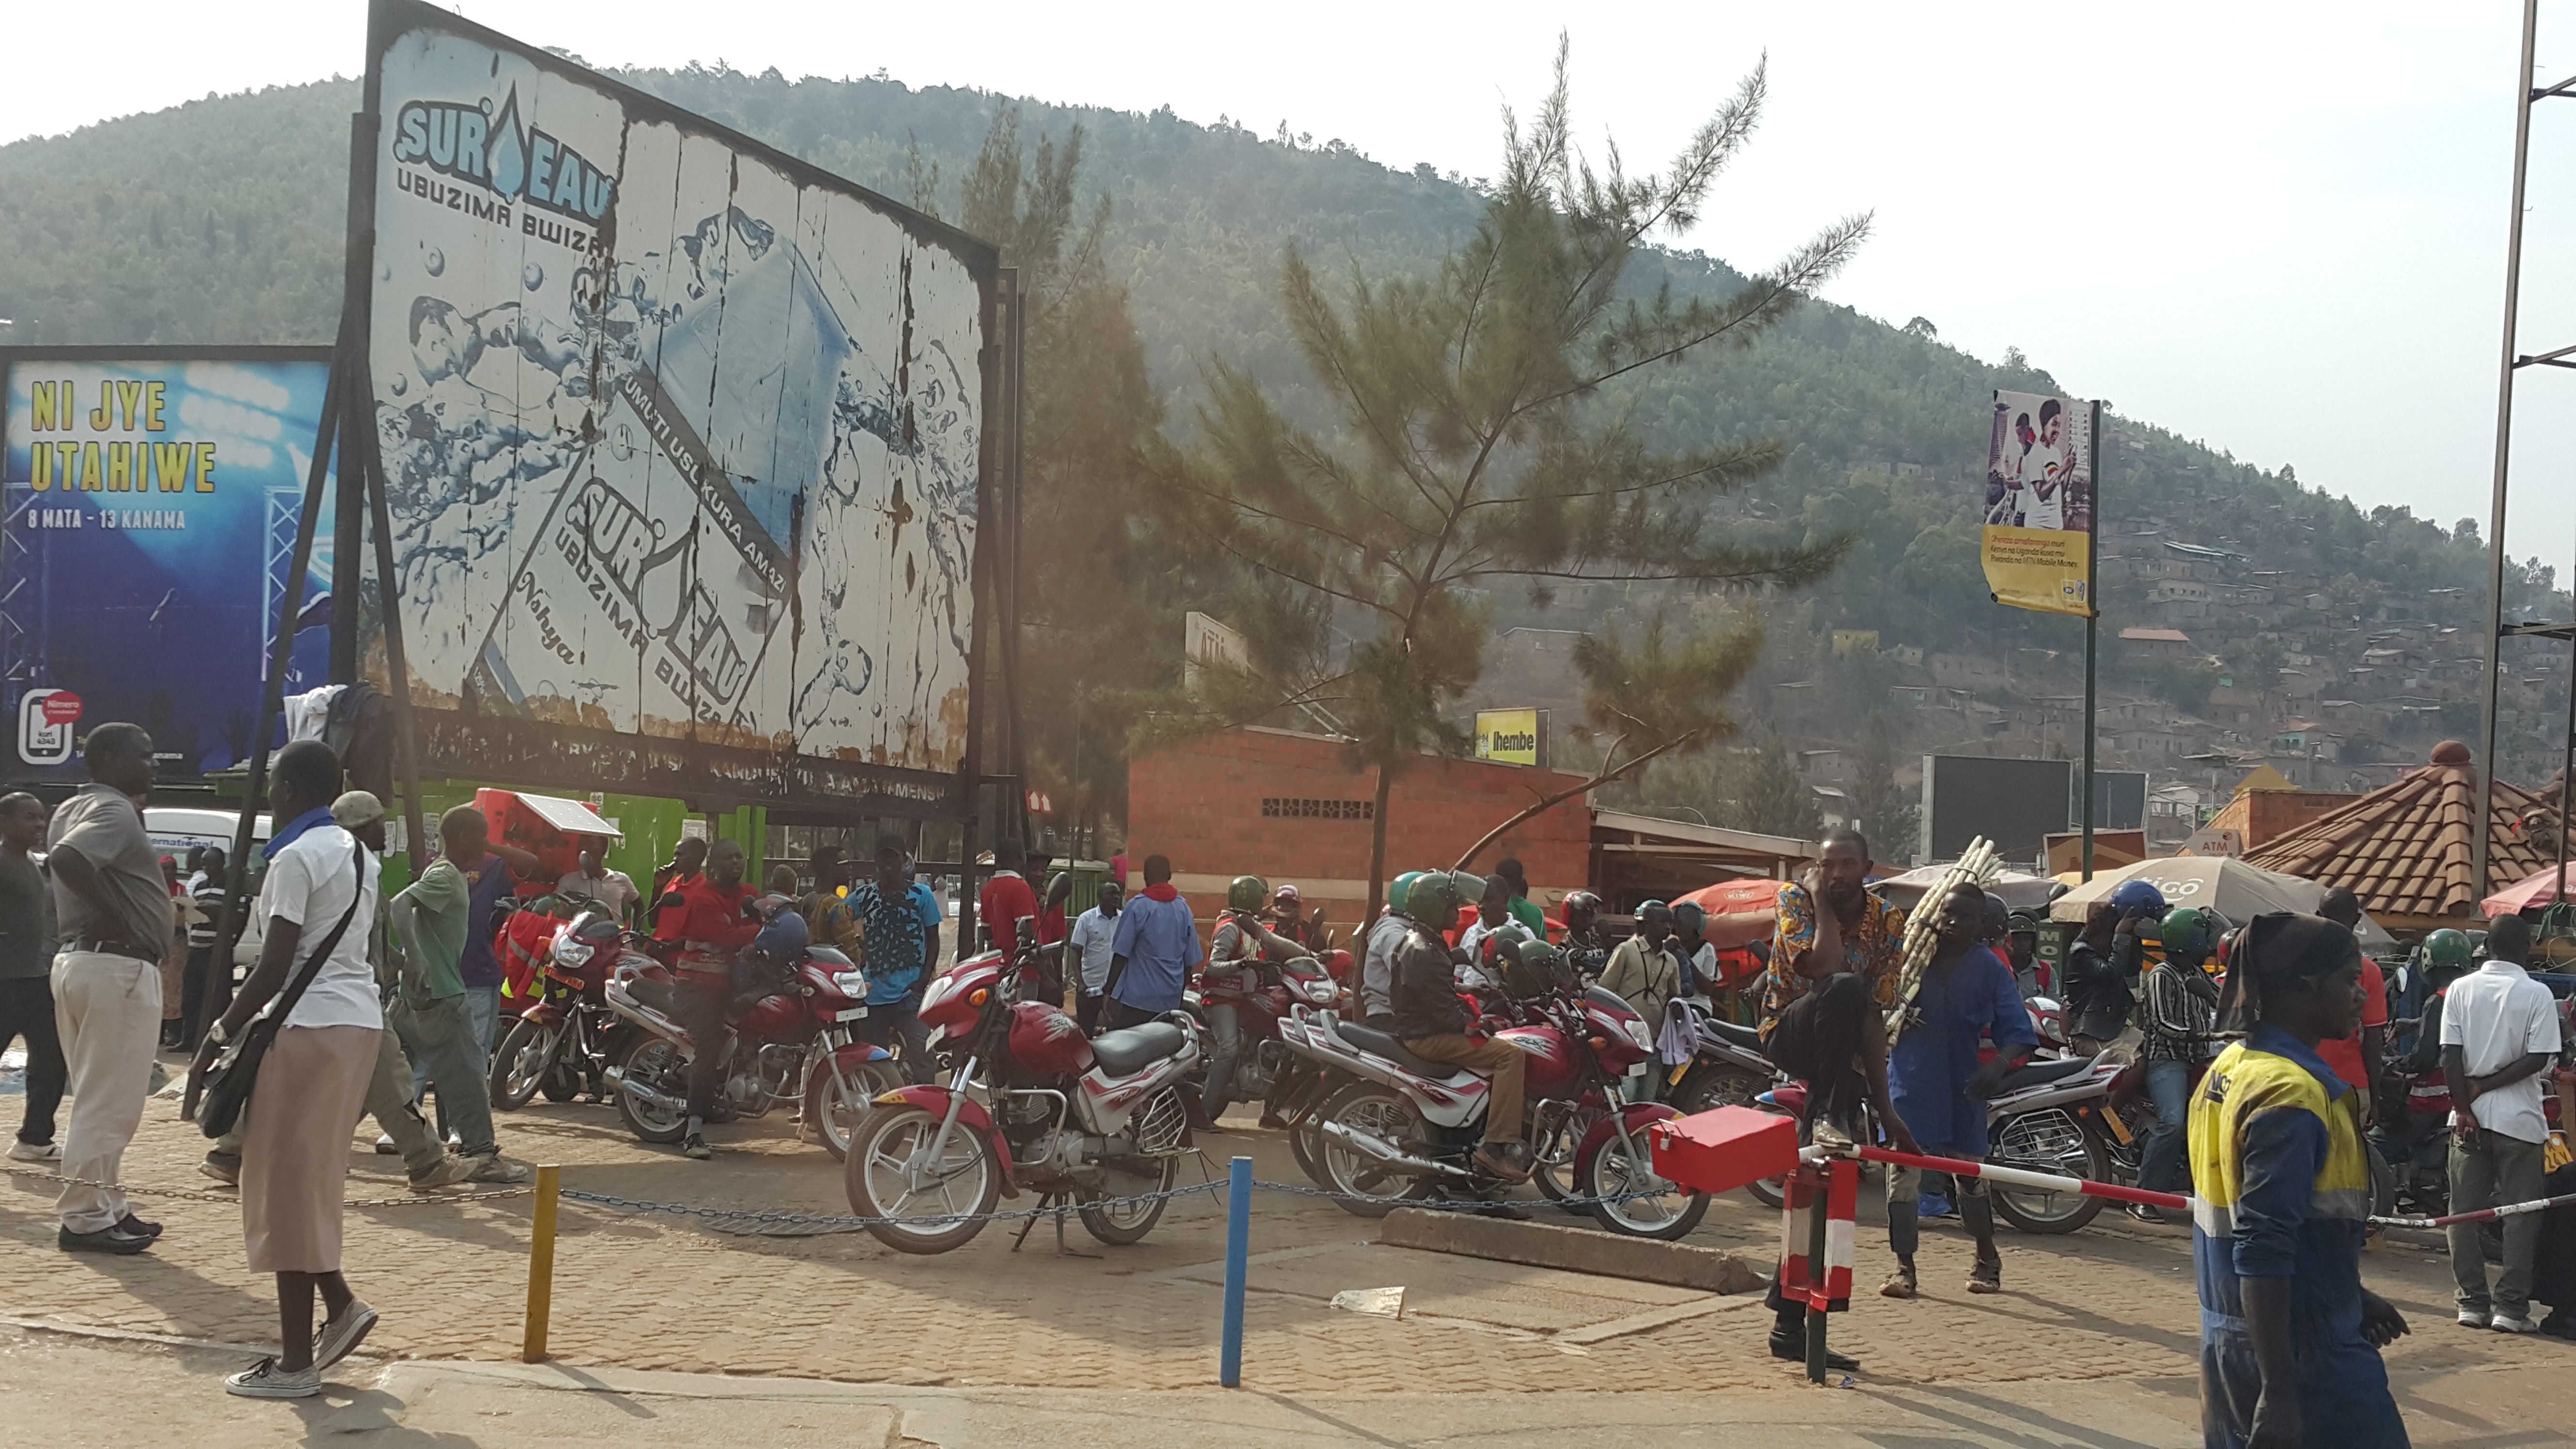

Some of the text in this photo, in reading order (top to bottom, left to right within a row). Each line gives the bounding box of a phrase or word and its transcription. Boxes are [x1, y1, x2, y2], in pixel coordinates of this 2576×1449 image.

[398, 167, 607, 259] UBUZIMA BWIZA
[32, 380, 166, 431] NI JYE
[31, 441, 216, 493] UTAHIWE
[28, 509, 38, 529] 8
[42, 509, 82, 530] MATA
[99, 510, 116, 530] 13
[121, 510, 186, 530] KANAMA
[743, 540, 787, 594] AMAZI
[2016, 547, 2039, 557] Uganda
[554, 526, 650, 658] UBUZIMA
[151, 837, 214, 848] ernational
[2202, 841, 2228, 852] ATM
